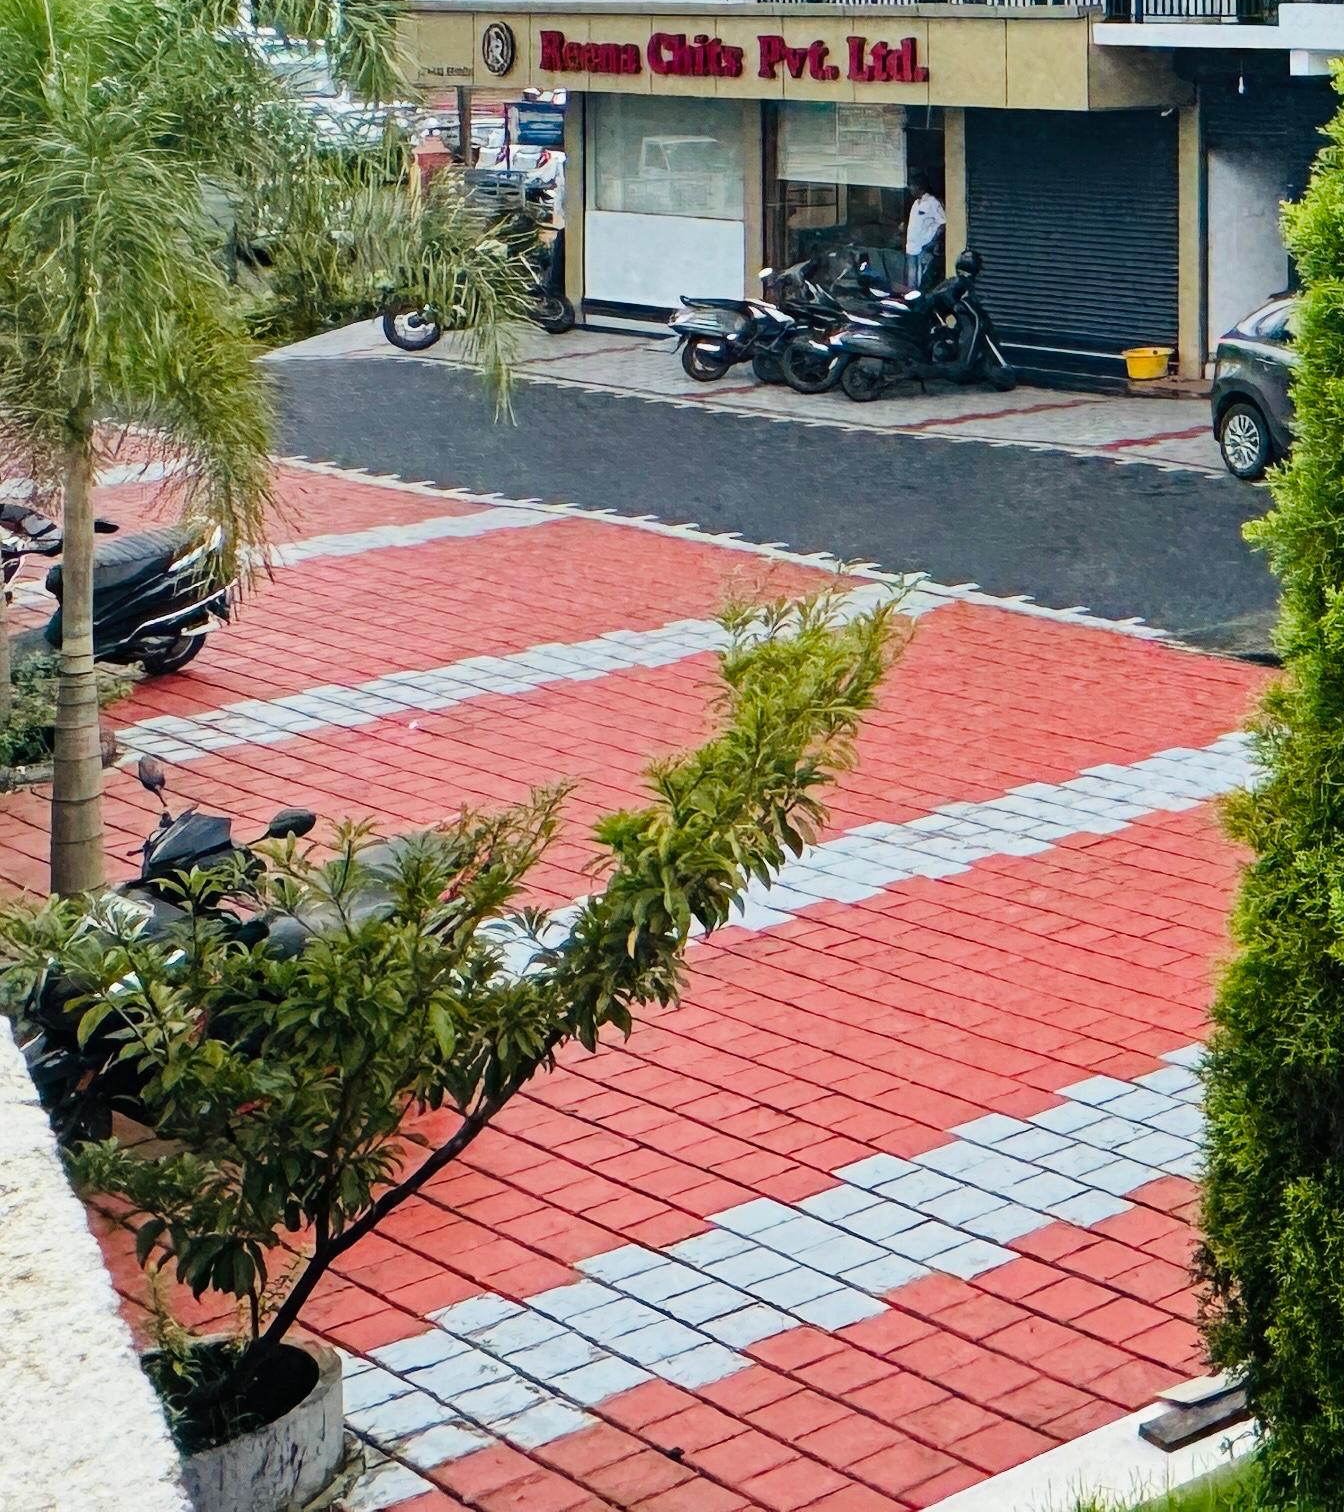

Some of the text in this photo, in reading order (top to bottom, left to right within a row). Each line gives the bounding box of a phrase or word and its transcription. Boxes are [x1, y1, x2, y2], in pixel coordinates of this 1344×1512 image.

[647, 32, 743, 77] Chits
[757, 35, 839, 80] Pvt.
[846, 36, 929, 82] Ltd.
